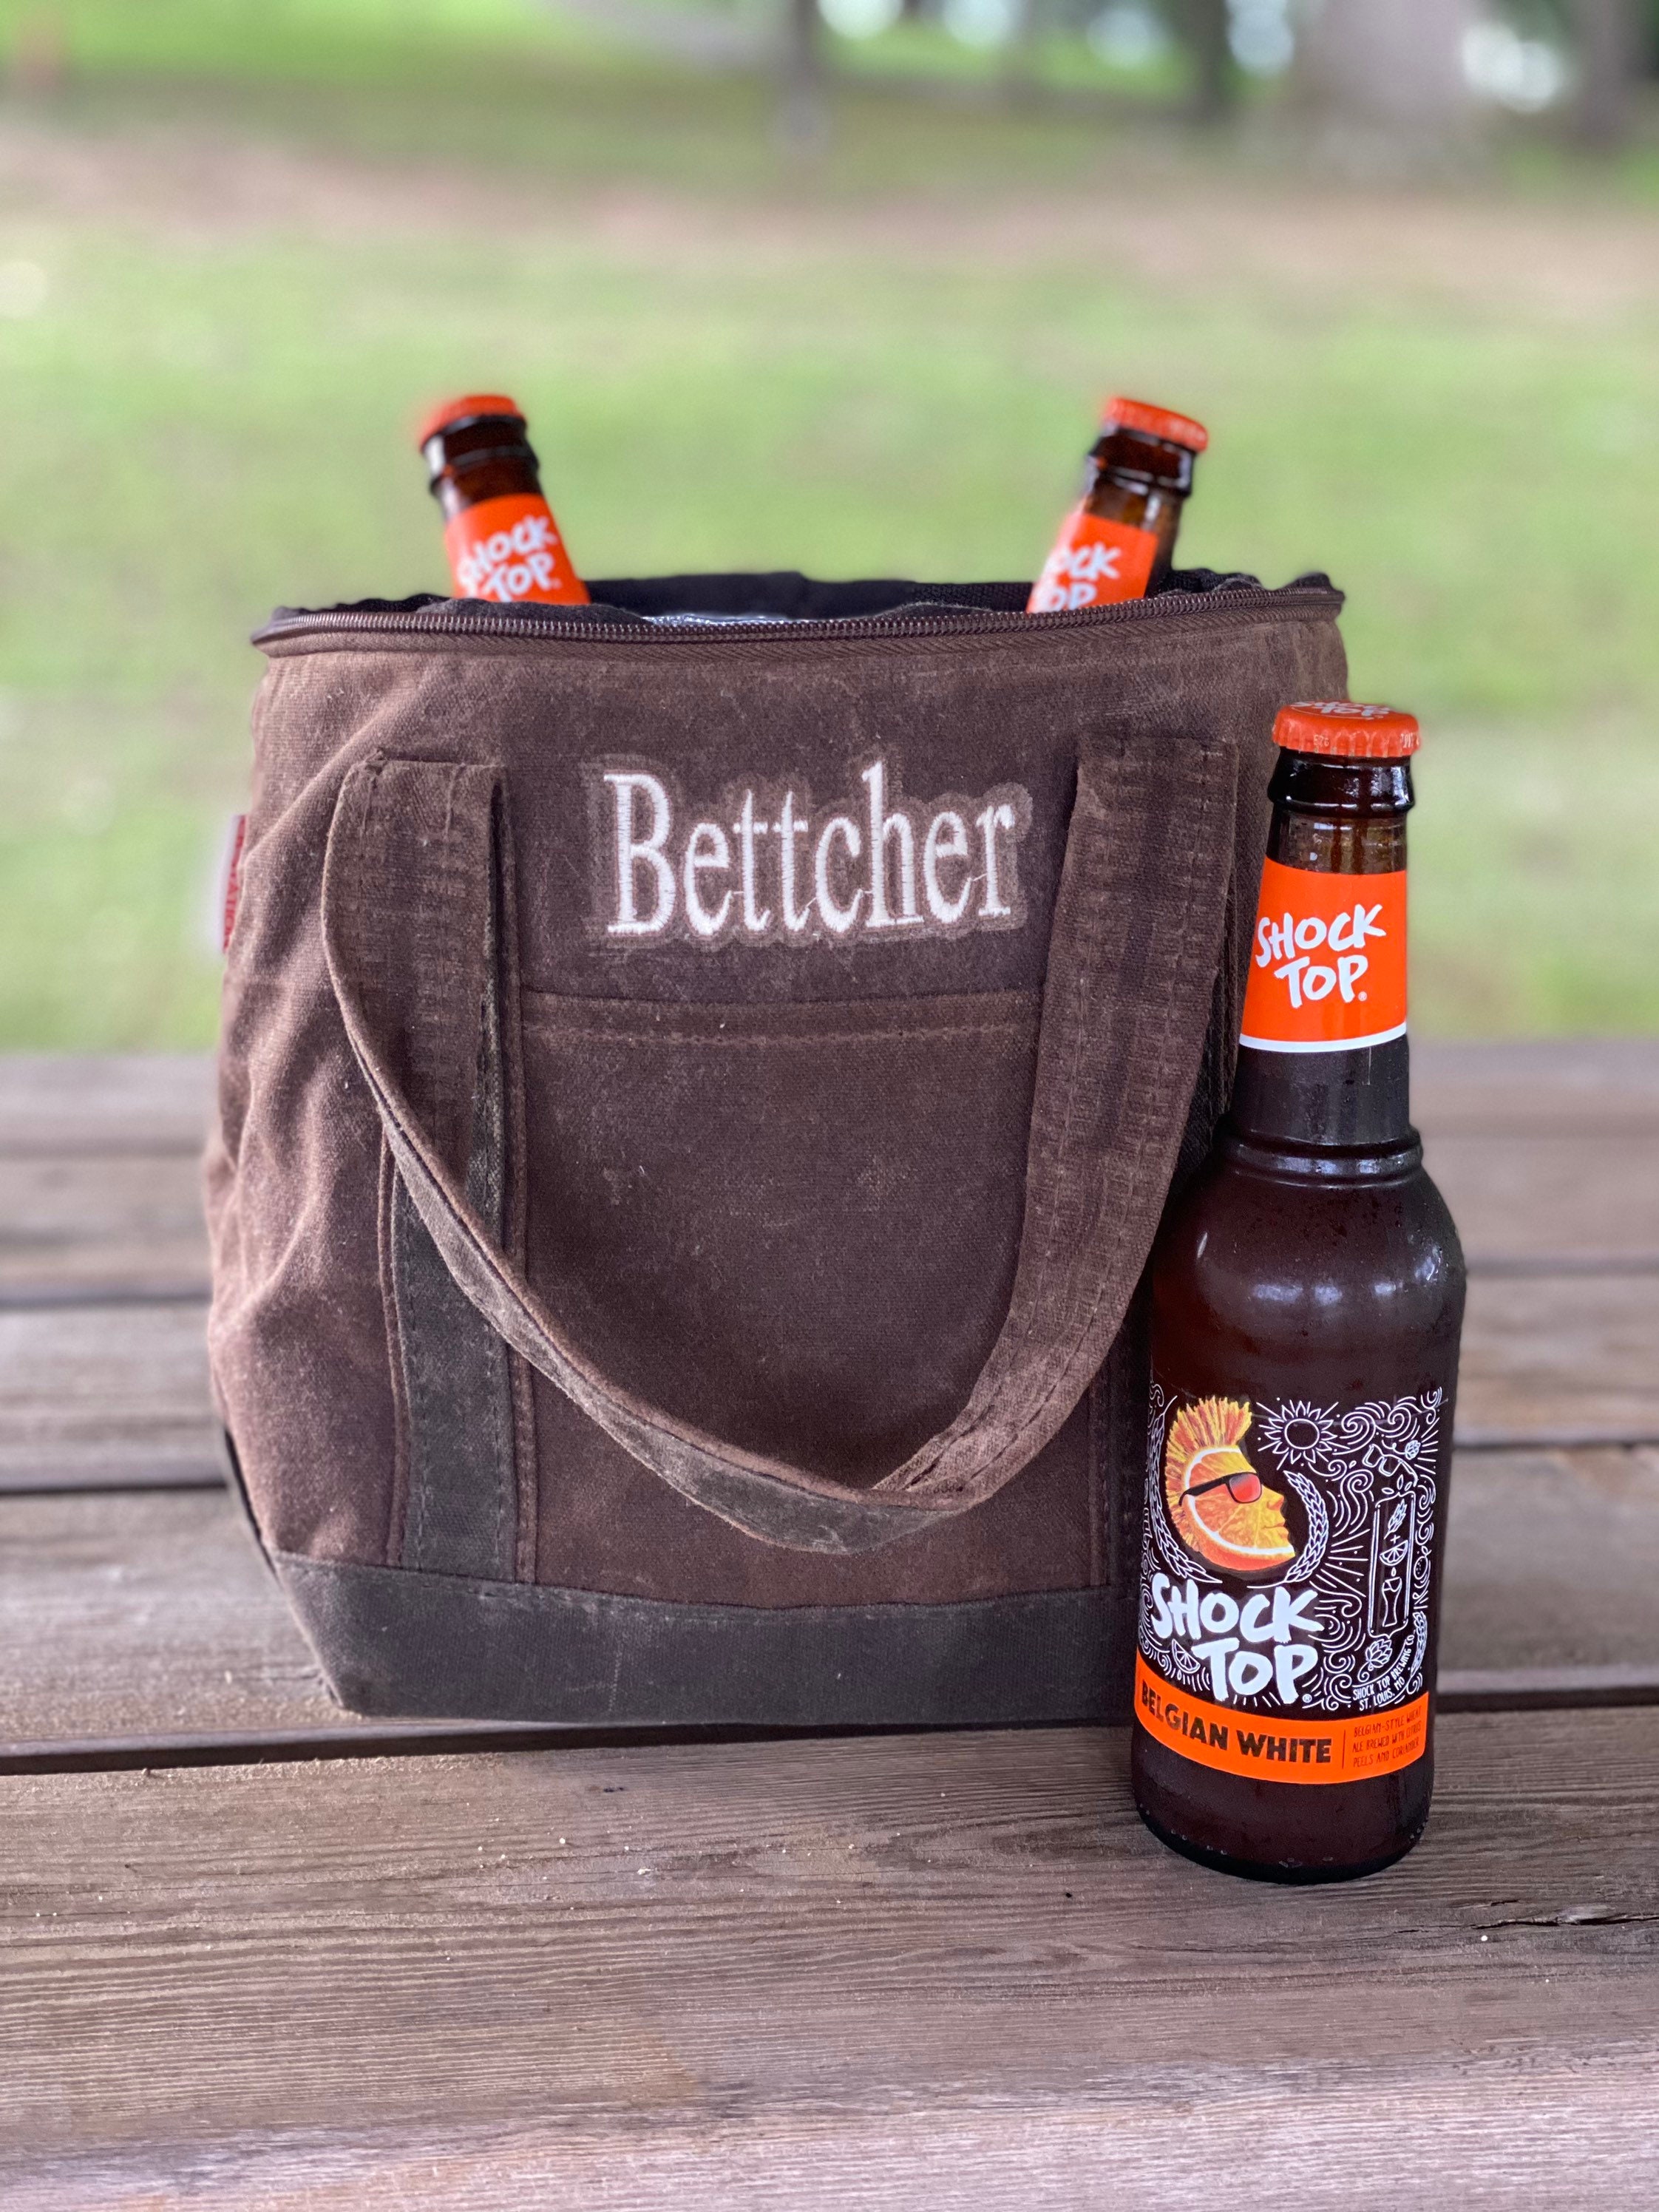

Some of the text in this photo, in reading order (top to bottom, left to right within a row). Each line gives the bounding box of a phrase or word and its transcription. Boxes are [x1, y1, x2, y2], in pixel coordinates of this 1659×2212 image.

[603, 761, 1015, 935] Bettcher
[1255, 903, 1386, 968] SHOCK
[1274, 954, 1368, 1008] TOP
[1151, 1573, 1325, 1643] SHOCK
[1191, 1637, 1318, 1704] TOP
[1353, 1683, 1374, 1700] SHOCK
[1377, 1675, 1391, 1691] TOP
[1391, 1648, 1412, 1680] BREWING
[1394, 1676, 1405, 1691] MO
[1141, 1678, 1332, 1763] BELGIAN WHITE
[1352, 1740, 1363, 1753] ALE
[1366, 1735, 1390, 1750] BREWED
[1391, 1730, 1405, 1744] WITH
[1353, 1754, 1374, 1768] PEELS
[1376, 1751, 1390, 1764] AND
